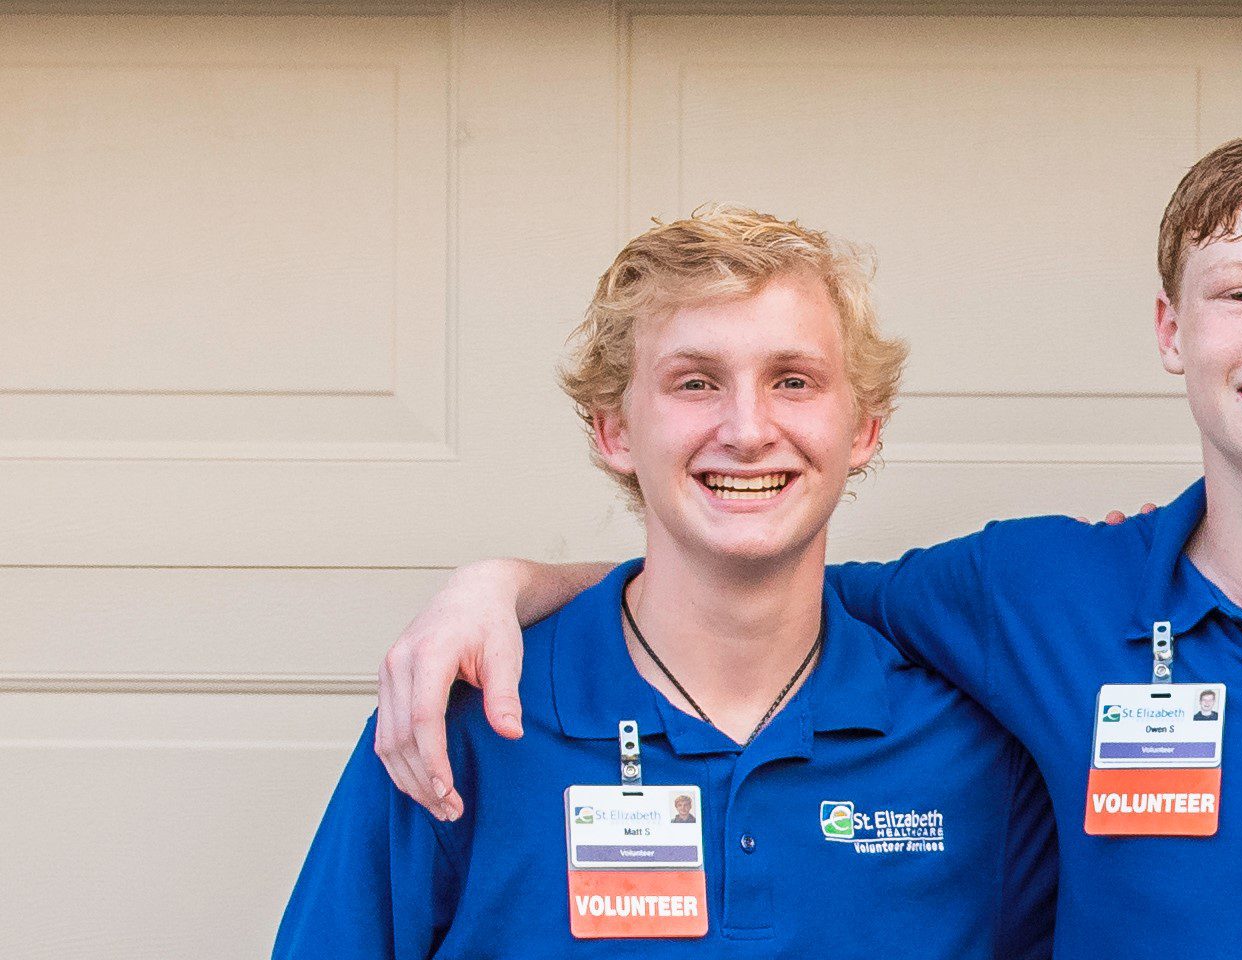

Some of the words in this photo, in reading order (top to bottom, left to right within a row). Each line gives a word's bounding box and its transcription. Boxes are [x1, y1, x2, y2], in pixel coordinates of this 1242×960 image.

[1122, 708, 1133, 718] St
[1136, 707, 1185, 719] Elizabeth
[1146, 725, 1167, 733] Owen
[1169, 725, 1175, 733] S
[1092, 793, 1215, 813] VOLUNTEER
[610, 809, 661, 820] Elizabeth
[874, 809, 943, 829] Elizabeth
[624, 828, 642, 836] Matt
[644, 828, 651, 836] S
[877, 827, 944, 838] HEALTHCARE
[854, 841, 904, 853] Volunteer
[619, 849, 655, 857] Volunteer
[575, 895, 698, 917] VOLUNTEER
